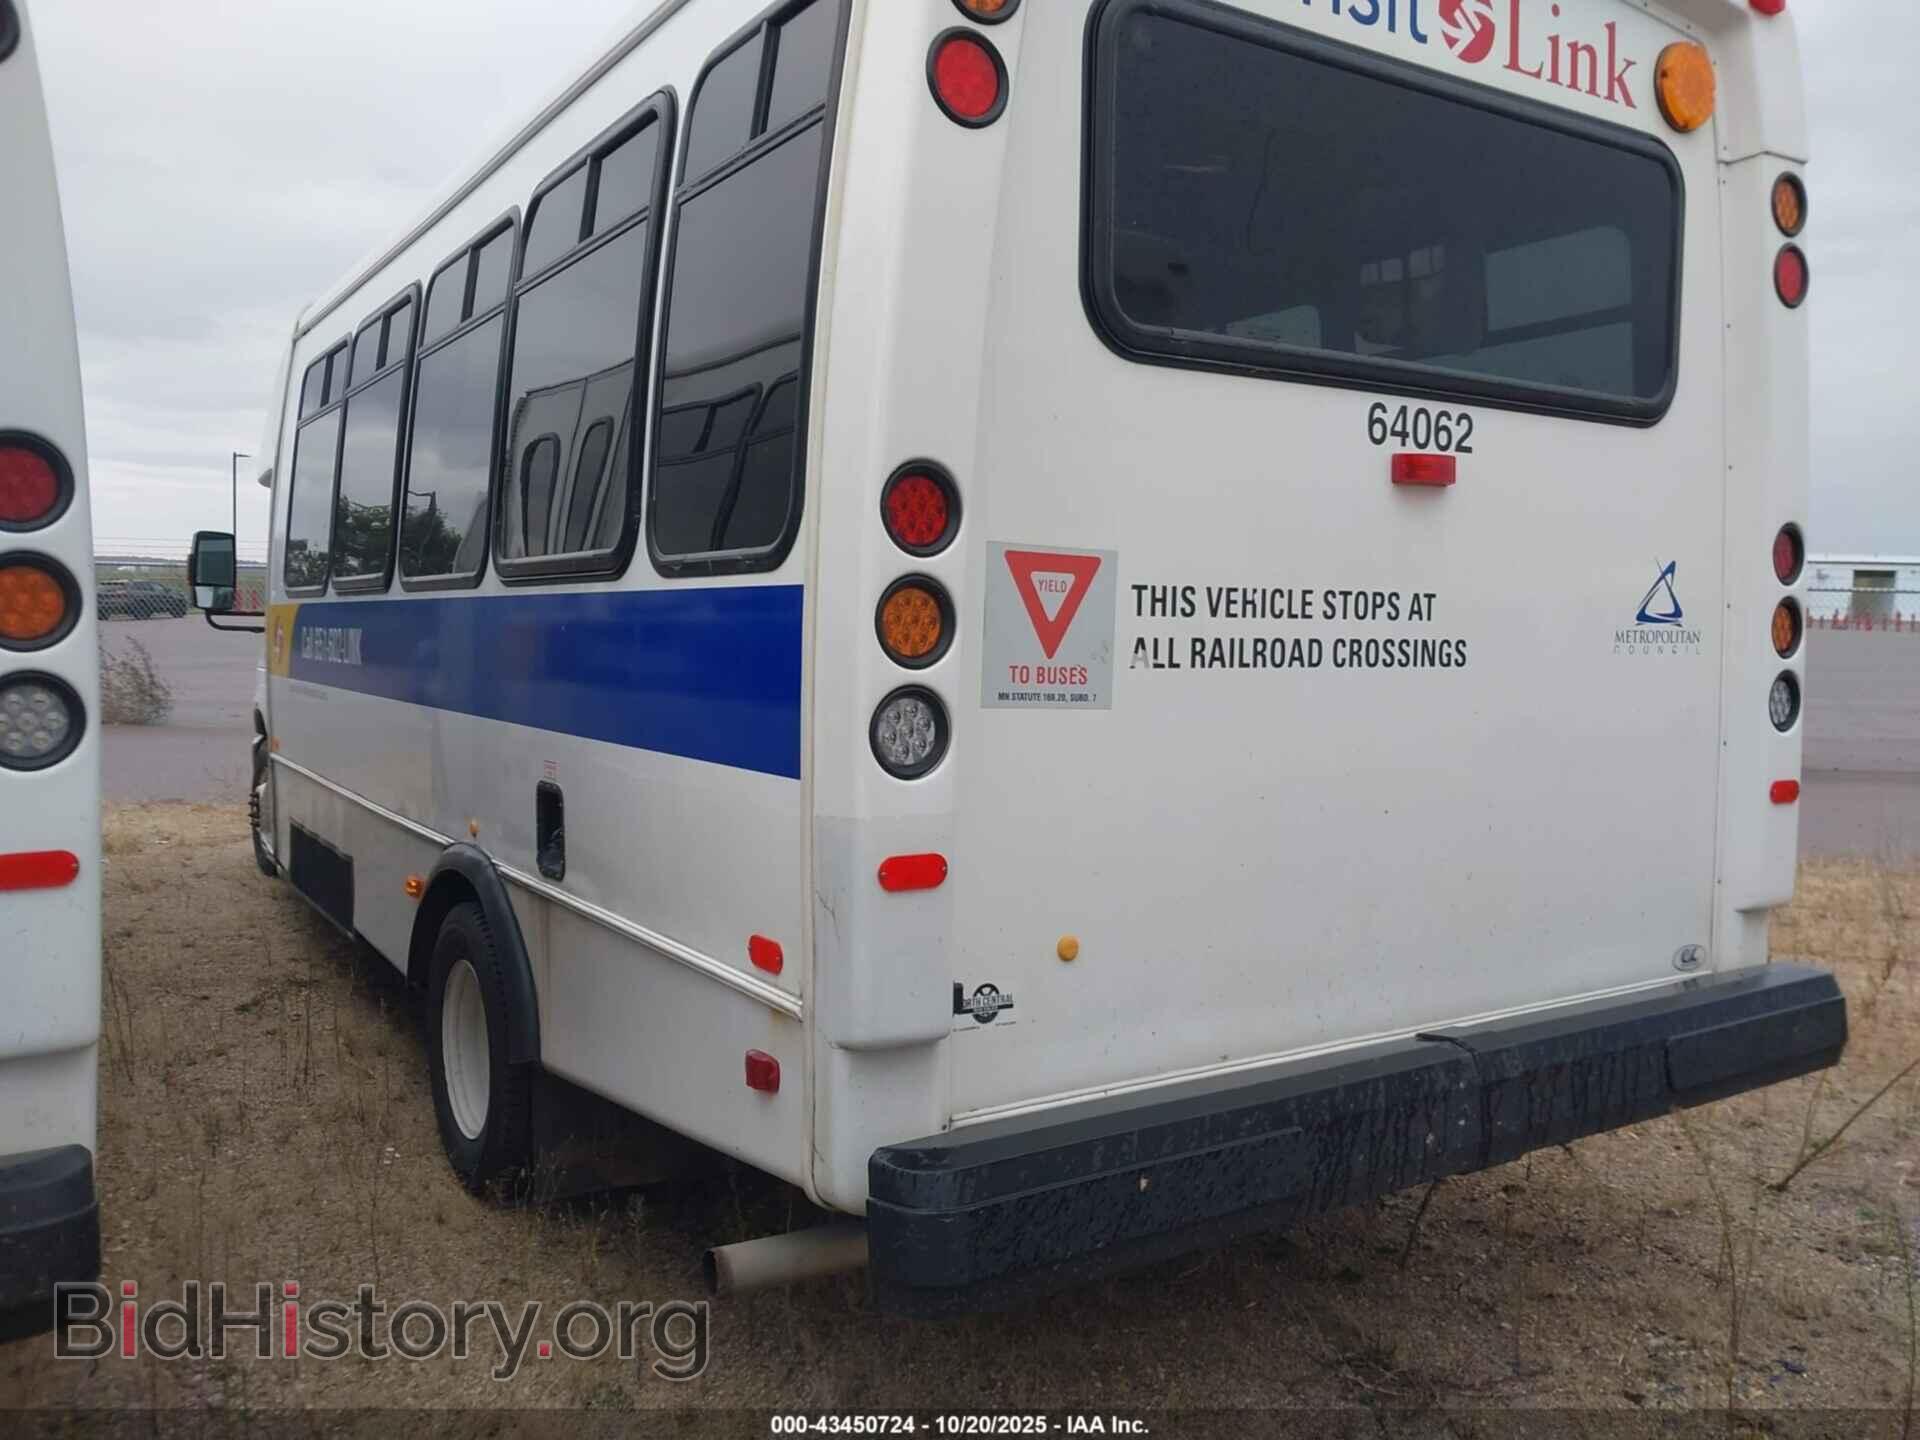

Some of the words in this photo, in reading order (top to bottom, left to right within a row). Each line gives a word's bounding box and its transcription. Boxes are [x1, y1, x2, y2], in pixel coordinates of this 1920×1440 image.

[1503, 0, 1637, 109] Link
[1368, 401, 1473, 453] 64062
[1038, 579, 1067, 592] YIELD
[1131, 585, 1196, 617] THIS
[1206, 587, 1313, 619] VEHICLE
[1323, 590, 1400, 621] STOPS
[1408, 593, 1436, 621] AT
[1615, 630, 1701, 643] METROPOLITAN
[1129, 637, 1180, 669] ALL
[1191, 638, 1322, 668] RAILROAD
[1333, 638, 1467, 668] CROSSINGS
[1010, 665, 1030, 684] TO
[1036, 665, 1088, 685] BUSES
[1012, 692, 1041, 702] STATUTE
